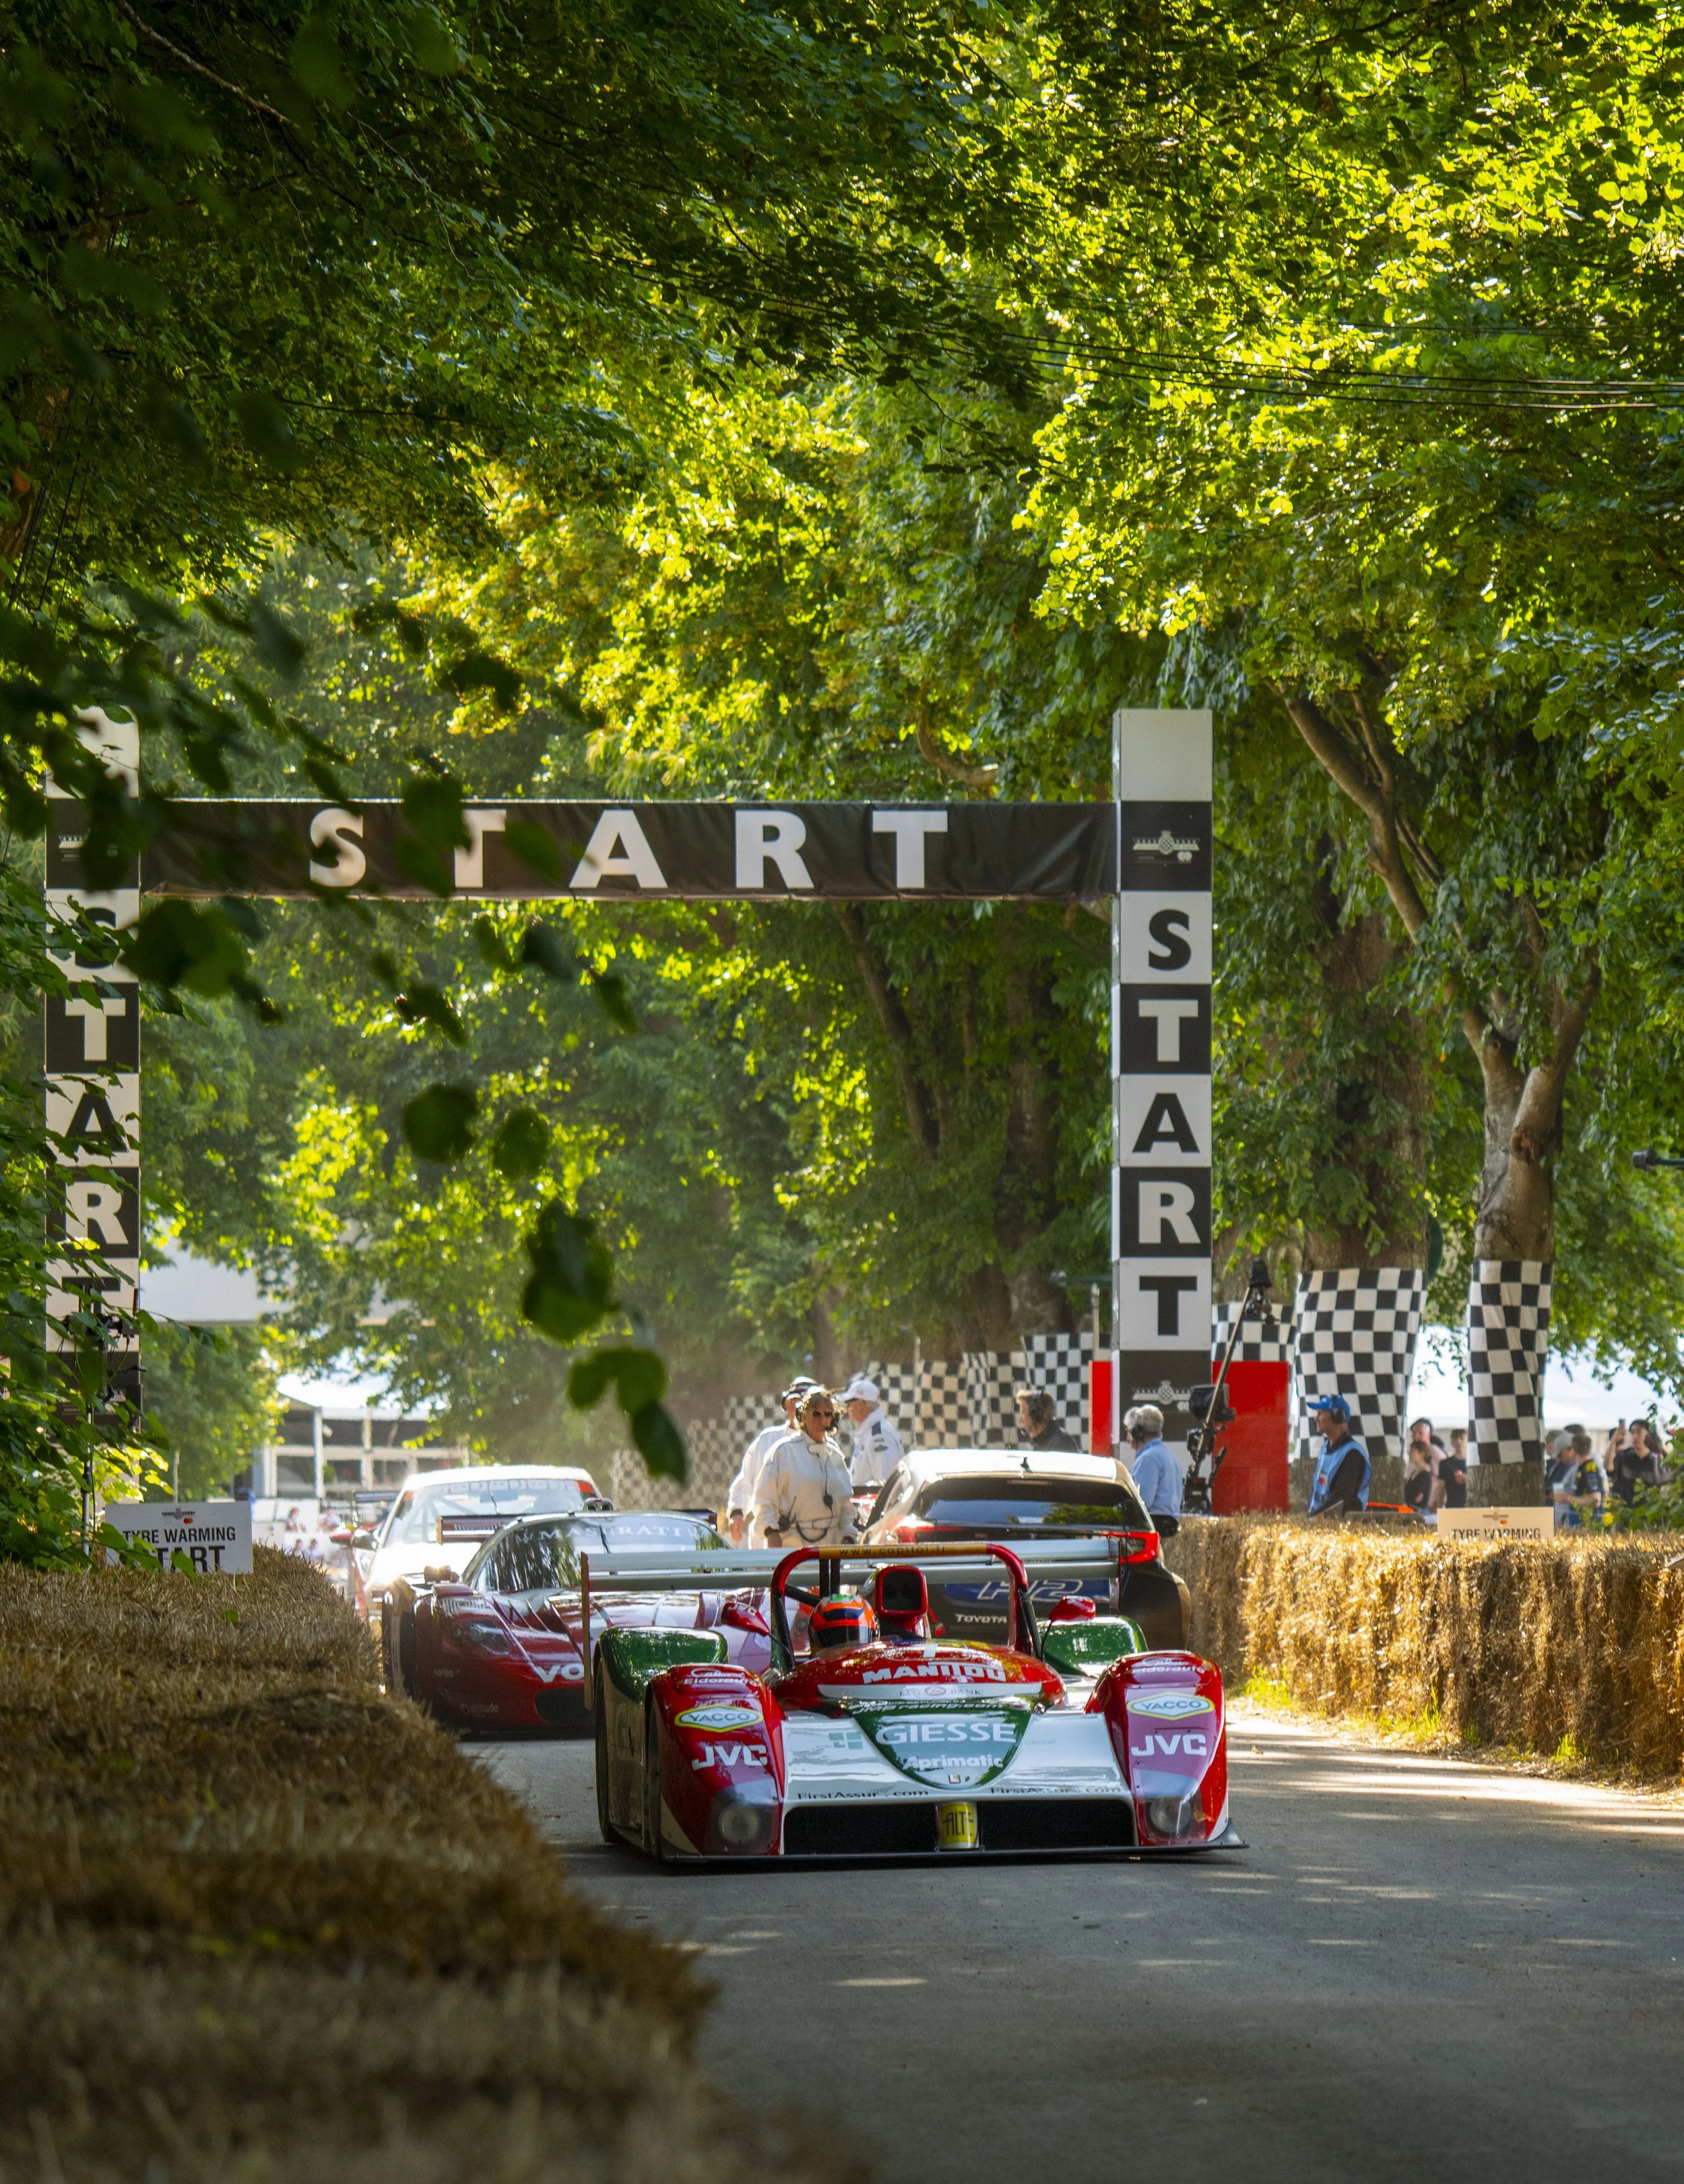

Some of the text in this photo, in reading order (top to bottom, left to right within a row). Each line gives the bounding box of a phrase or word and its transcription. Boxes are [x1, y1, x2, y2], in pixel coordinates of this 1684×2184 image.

[310, 807, 949, 889] START
[1132, 909, 1201, 1336] START
[122, 1526, 236, 1544] TYRE WARMING
[540, 1525, 684, 1541] MASERATI
[139, 1545, 226, 1573] TRT
[954, 1614, 1008, 1624] TOYOTA
[862, 1661, 1006, 1684] MANITOU
[1141, 1700, 1202, 1711] YACCO
[688, 1713, 750, 1722] YACCO
[876, 1722, 1016, 1745] GIESSE
[1131, 1733, 1207, 1757] JVC
[691, 1744, 768, 1771] JVC
[902, 1754, 1004, 1772] Aprimatic
